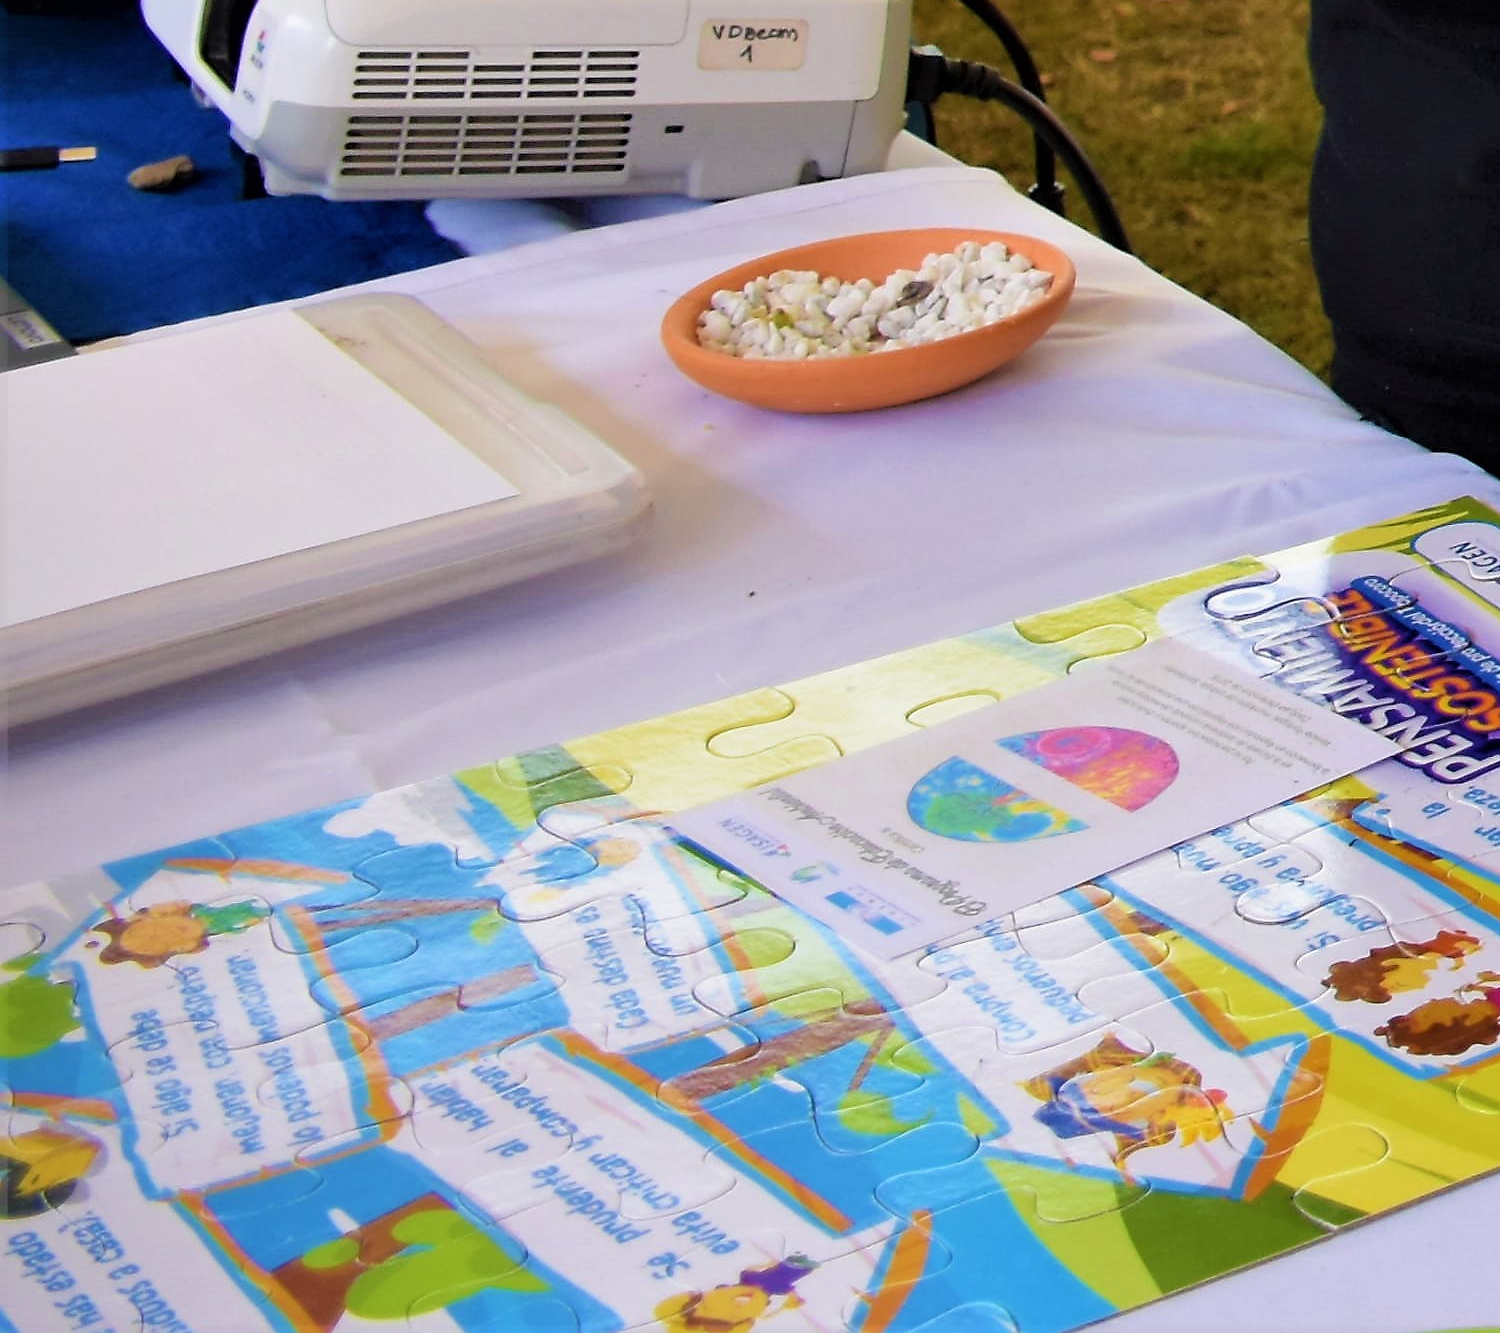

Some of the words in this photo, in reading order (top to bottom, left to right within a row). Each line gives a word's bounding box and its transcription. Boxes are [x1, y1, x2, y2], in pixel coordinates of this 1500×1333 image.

[739, 44, 752, 63] 1
[1421, 801, 1451, 820] la
[417, 1080, 494, 1134] hablar
[486, 1138, 529, 1160] al
[529, 1164, 651, 1246] prudente
[578, 1149, 681, 1212] criticar
[670, 1209, 741, 1258] evita
[6, 1230, 78, 1301] estado
